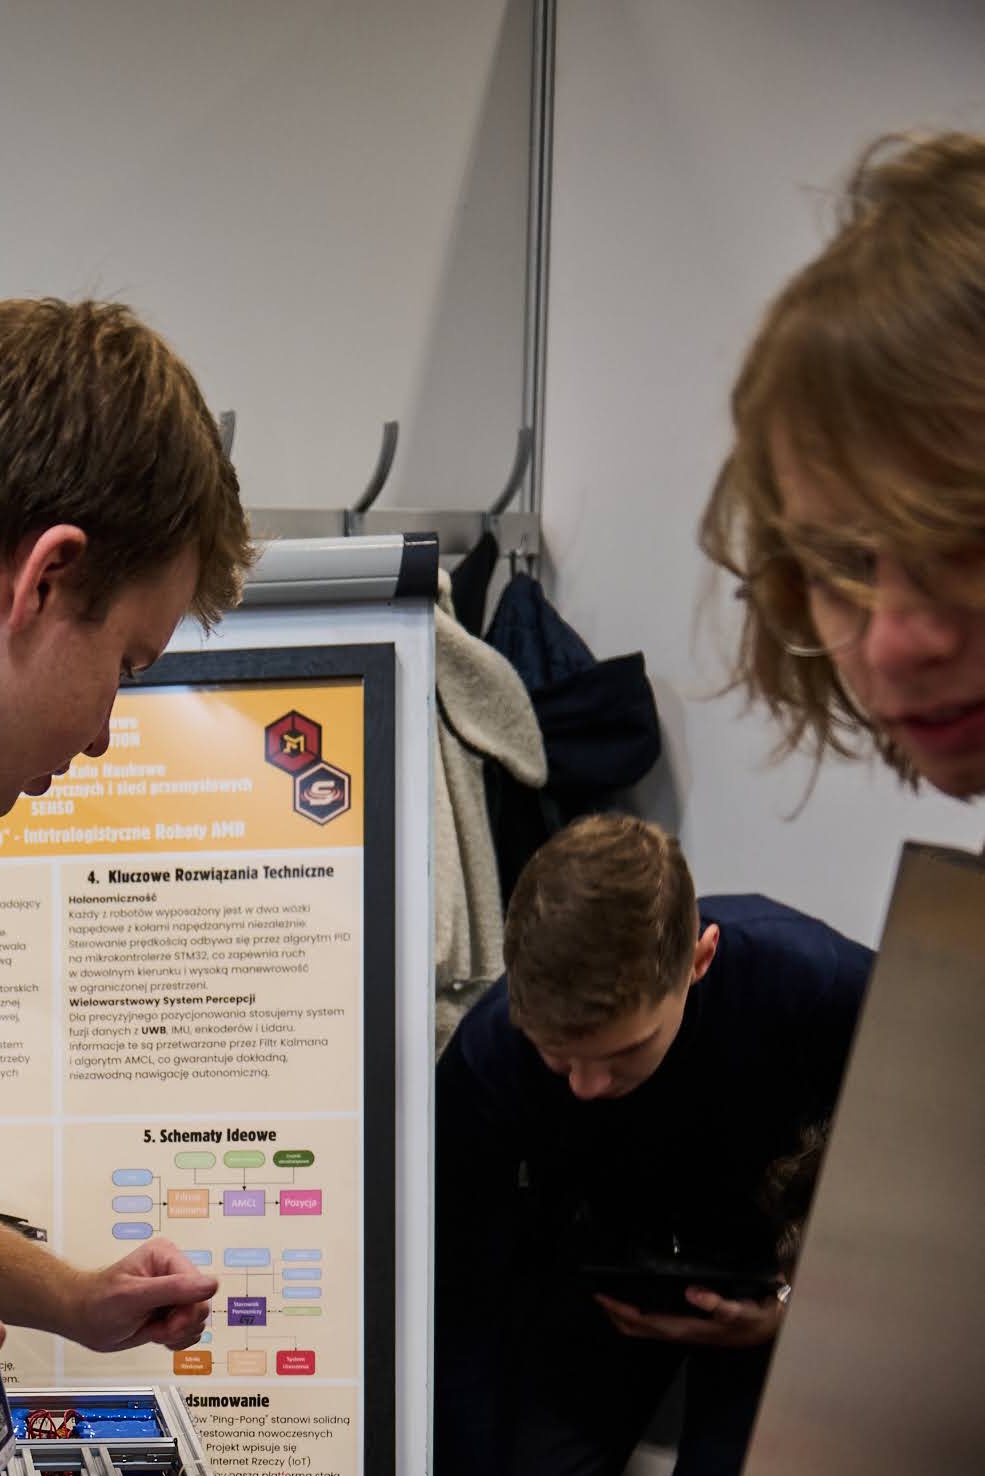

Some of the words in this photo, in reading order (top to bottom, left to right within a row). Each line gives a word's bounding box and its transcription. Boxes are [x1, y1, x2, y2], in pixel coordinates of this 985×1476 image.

[87, 870, 100, 884] 4.
[108, 869, 171, 884] Kluczowe
[175, 866, 259, 884] Rozwiązania
[262, 864, 335, 879] Techniczne
[68, 893, 158, 905] Holonomiczność
[68, 908, 99, 920] Każdy
[109, 908, 153, 918] robotów
[222, 904, 243, 918] jest
[255, 904, 280, 914] dwa
[190, 935, 233, 947] odbywa
[228, 949, 279, 960] zapewnia
[281, 948, 306, 958] ruch
[79, 968, 135, 980] dowolnym
[137, 966, 182, 977] kierunku
[68, 997, 161, 1007] Wielowarstwowy
[163, 995, 203, 1007] System
[206, 992, 257, 1006] Percepcji
[249, 1008, 304, 1020] stosujemy
[306, 1008, 345, 1019] system
[91, 1026, 132, 1038] danych
[229, 1039, 257, 1050] przez
[280, 1037, 329, 1047] Kalmana
[143, 1129, 156, 1143] 5.
[159, 1128, 223, 1144] Schematy
[226, 1128, 277, 1142] Ideowe
[283, 1198, 318, 1210] Pozycja
[185, 1393, 270, 1408] dsumowanie
[209, 1414, 269, 1427] "Ping-Pong"
[271, 1415, 311, 1425] stanowi
[313, 1415, 351, 1426] solidną
[199, 1429, 256, 1438] testowania
[258, 1429, 333, 1440] nowoczesnych
[206, 1442, 239, 1453] Projekt
[242, 1443, 281, 1454] wpisuje
[283, 1443, 297, 1454] się
[210, 1457, 249, 1466] Internet
[251, 1457, 285, 1467] Rzeczy
[287, 1457, 311, 1467] (IoT)
